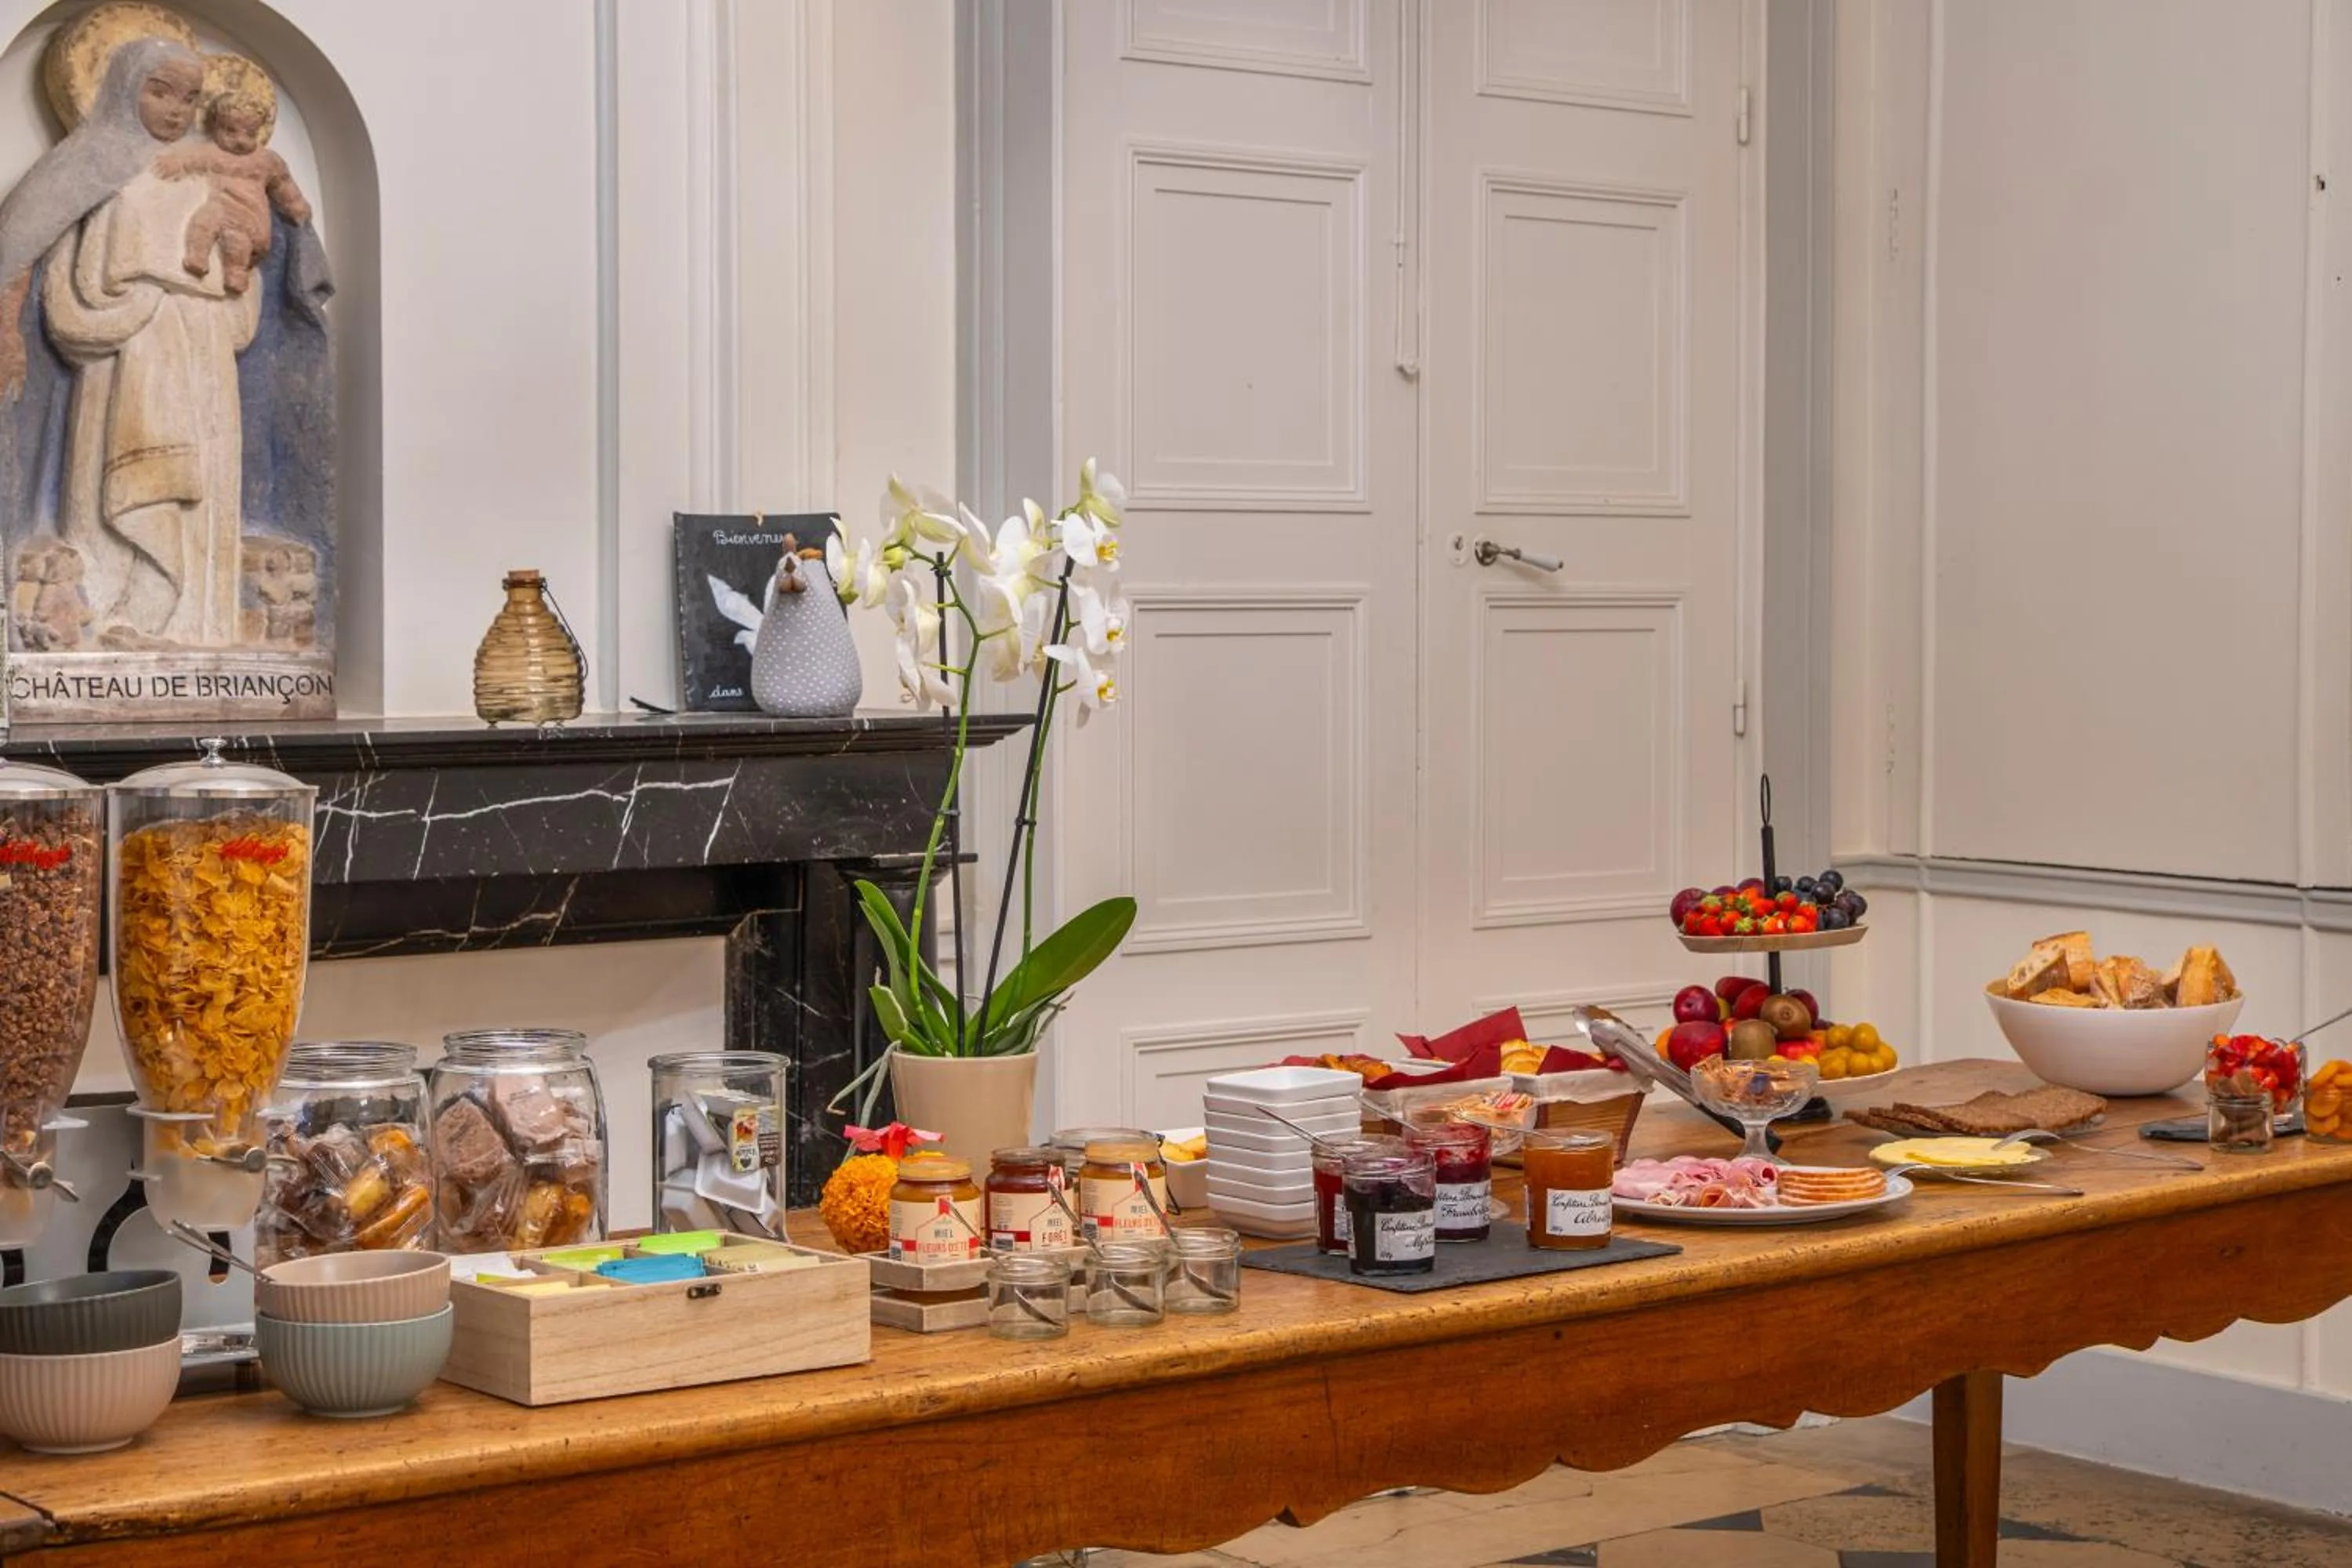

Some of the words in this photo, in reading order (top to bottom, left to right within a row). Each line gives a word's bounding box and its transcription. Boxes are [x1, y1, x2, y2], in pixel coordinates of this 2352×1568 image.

[713, 530, 784, 545] Bienvenu
[9, 671, 142, 699] CHÂTEAU
[152, 676, 188, 697] DE
[197, 675, 333, 704] BRIANÇON
[709, 684, 743, 699] dans
[934, 1229, 953, 1239] MIEL
